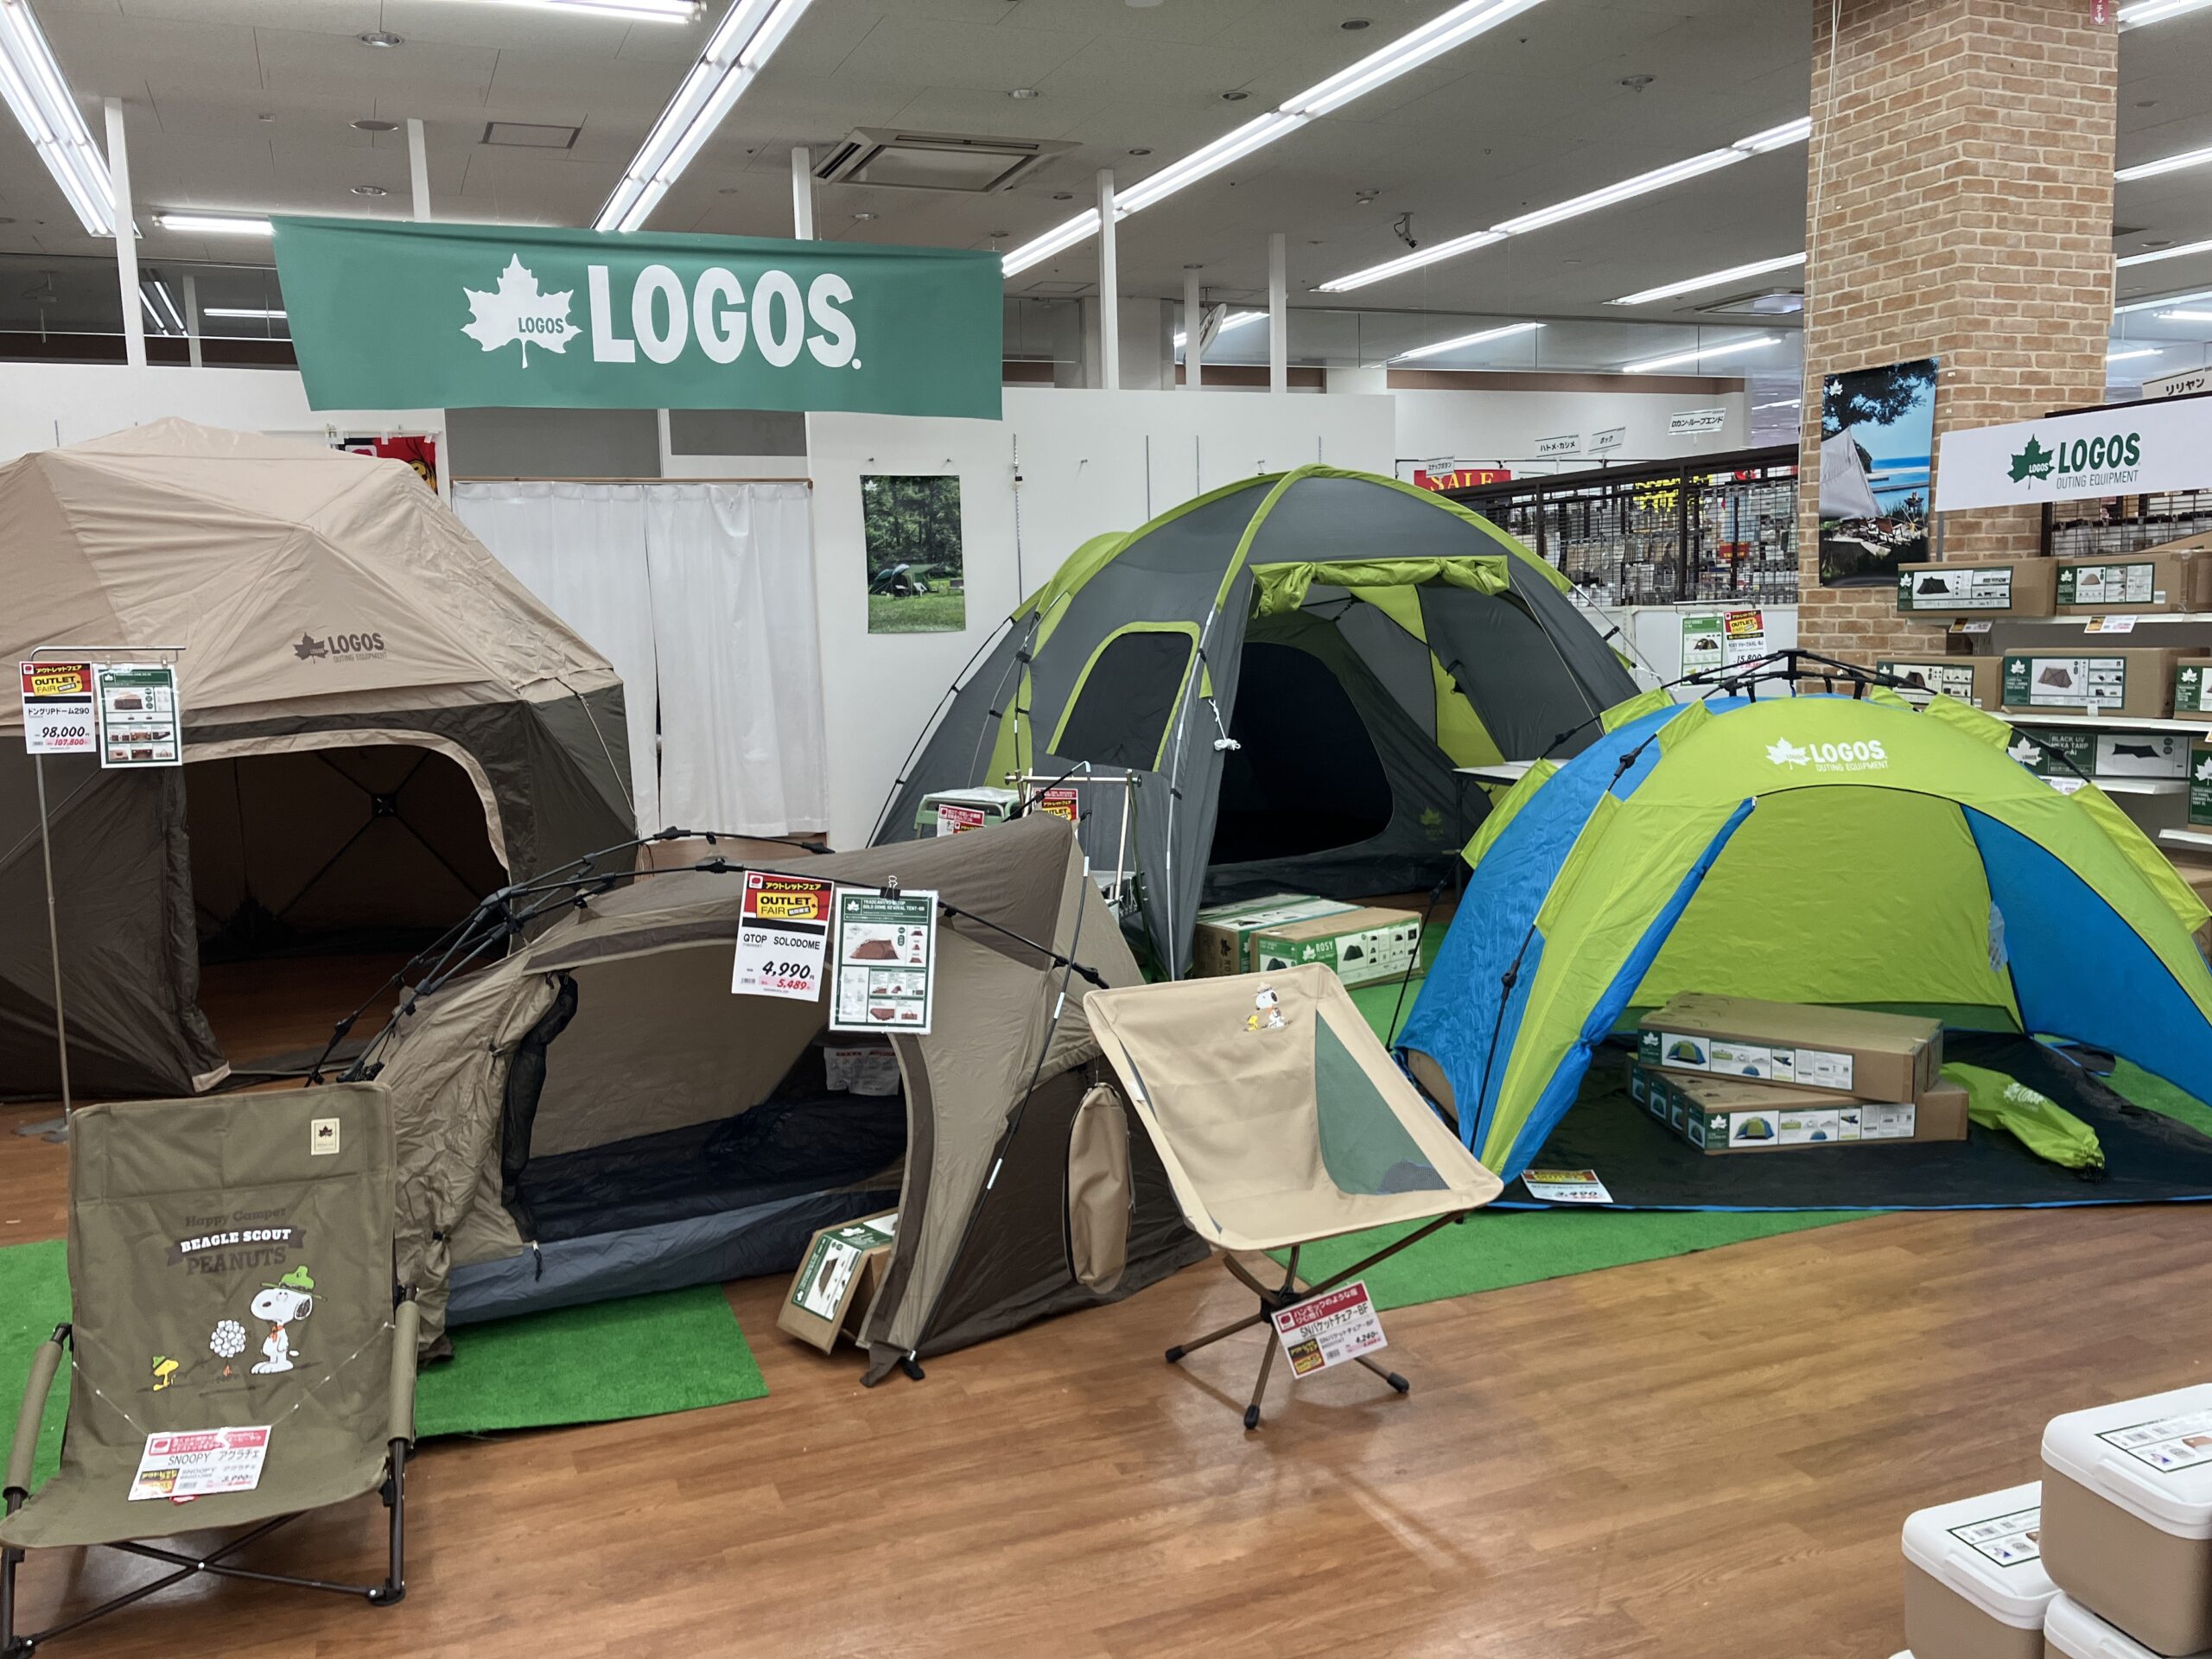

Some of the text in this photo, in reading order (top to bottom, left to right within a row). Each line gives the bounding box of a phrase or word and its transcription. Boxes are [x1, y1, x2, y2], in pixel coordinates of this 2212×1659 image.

[518, 316, 563, 334] LOGOS
[2165, 378, 2205, 396] リリヤン
[2058, 432, 2140, 474] LOGOS
[2029, 462, 2049, 474] LOGOS
[2056, 470, 2139, 490] OUTING EQUIPMENT
[328, 632, 385, 654] LOGOS
[333, 652, 387, 664] OUTING EQUIPMENT
[35, 664, 82, 674] アウトレットフェア
[35, 677, 75, 686] OUTLET
[42, 727, 85, 738] 98,000
[1809, 740, 1886, 763] LOGOS
[1815, 760, 1889, 772] OUTING EQUIPMENT
[766, 882, 822, 891] アウトレットフェア
[760, 896, 811, 906] OUTLET
[761, 906, 785, 915] FAIR
[743, 933, 767, 944] QTOP
[773, 936, 821, 950] SOLODOME
[1315, 940, 1333, 953] ROSY
[762, 961, 810, 979] 4,990
[777, 979, 807, 990] 5,489
[185, 1208, 286, 1229] Happy Camper
[180, 1229, 292, 1253] BEAGLE SCOUT
[186, 1247, 287, 1276] PEANUTS
[168, 1452, 211, 1466] SNOOPY
